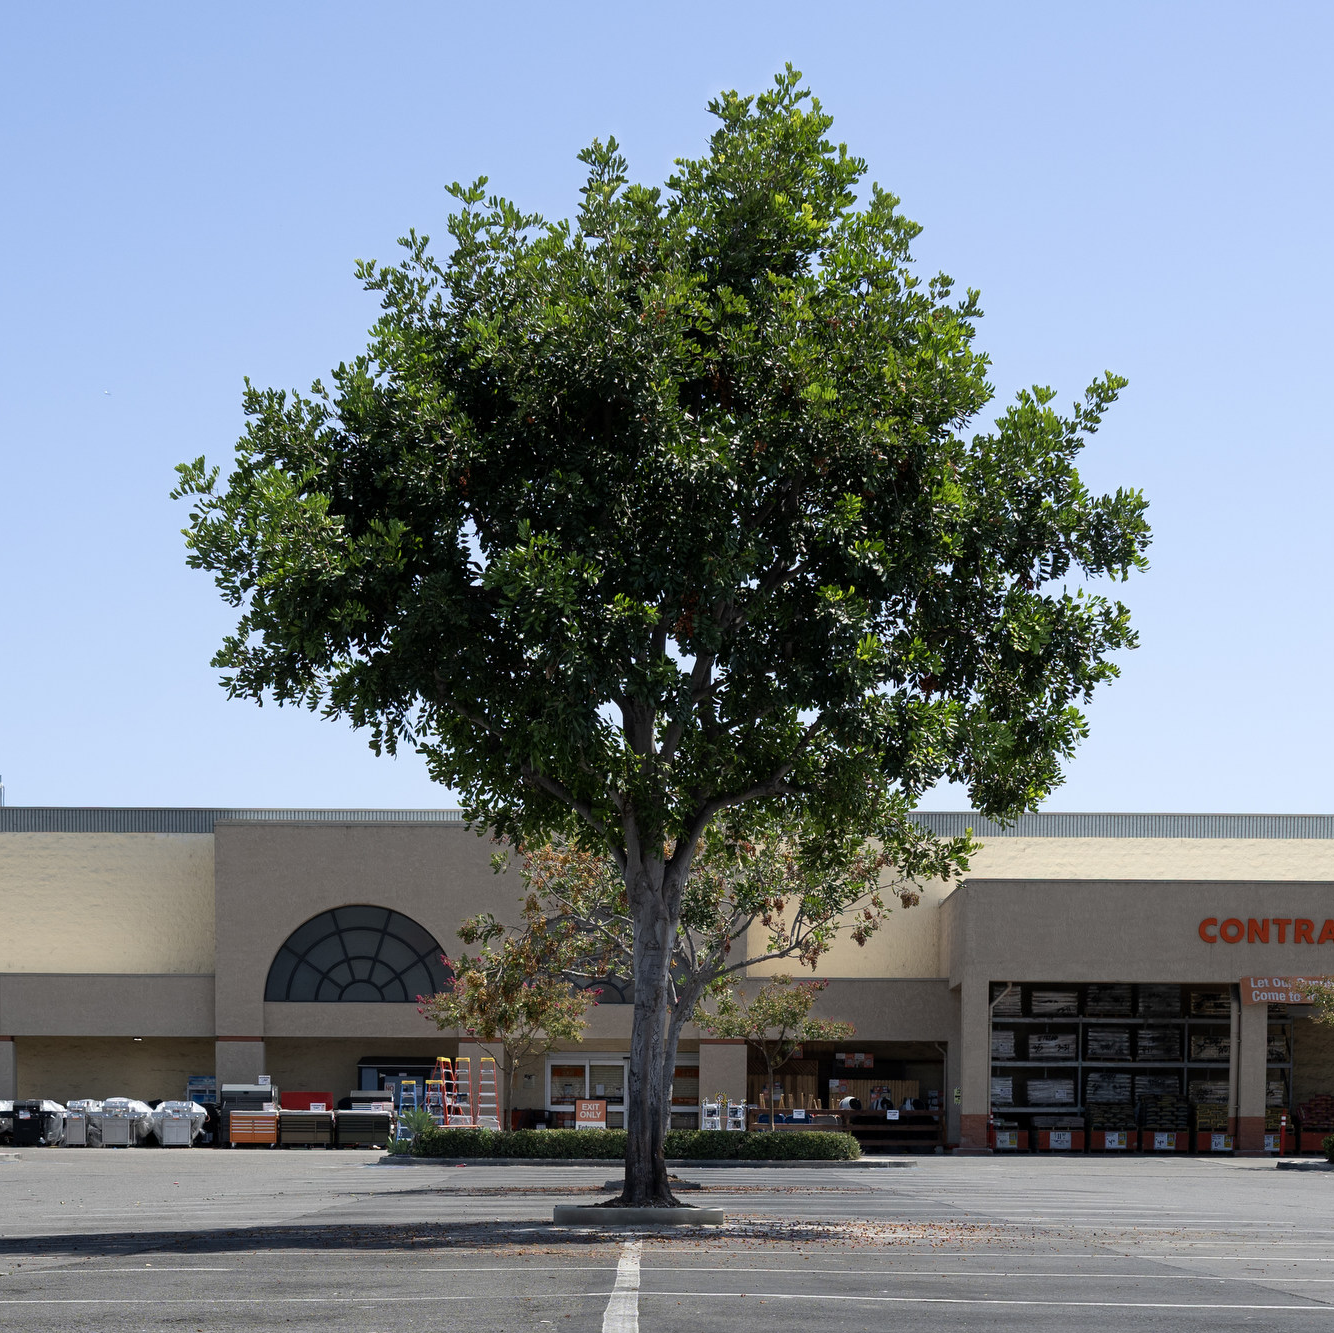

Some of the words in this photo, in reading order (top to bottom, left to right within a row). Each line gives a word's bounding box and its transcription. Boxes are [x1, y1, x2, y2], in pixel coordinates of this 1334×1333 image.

[1250, 977, 1270, 988] Let
[1273, 977, 1292, 988] Ou
[1252, 990, 1286, 1002] Come
[1289, 991, 1301, 1002] to
[582, 1103, 600, 1111] EXIT
[579, 1111, 602, 1119] ONLY
